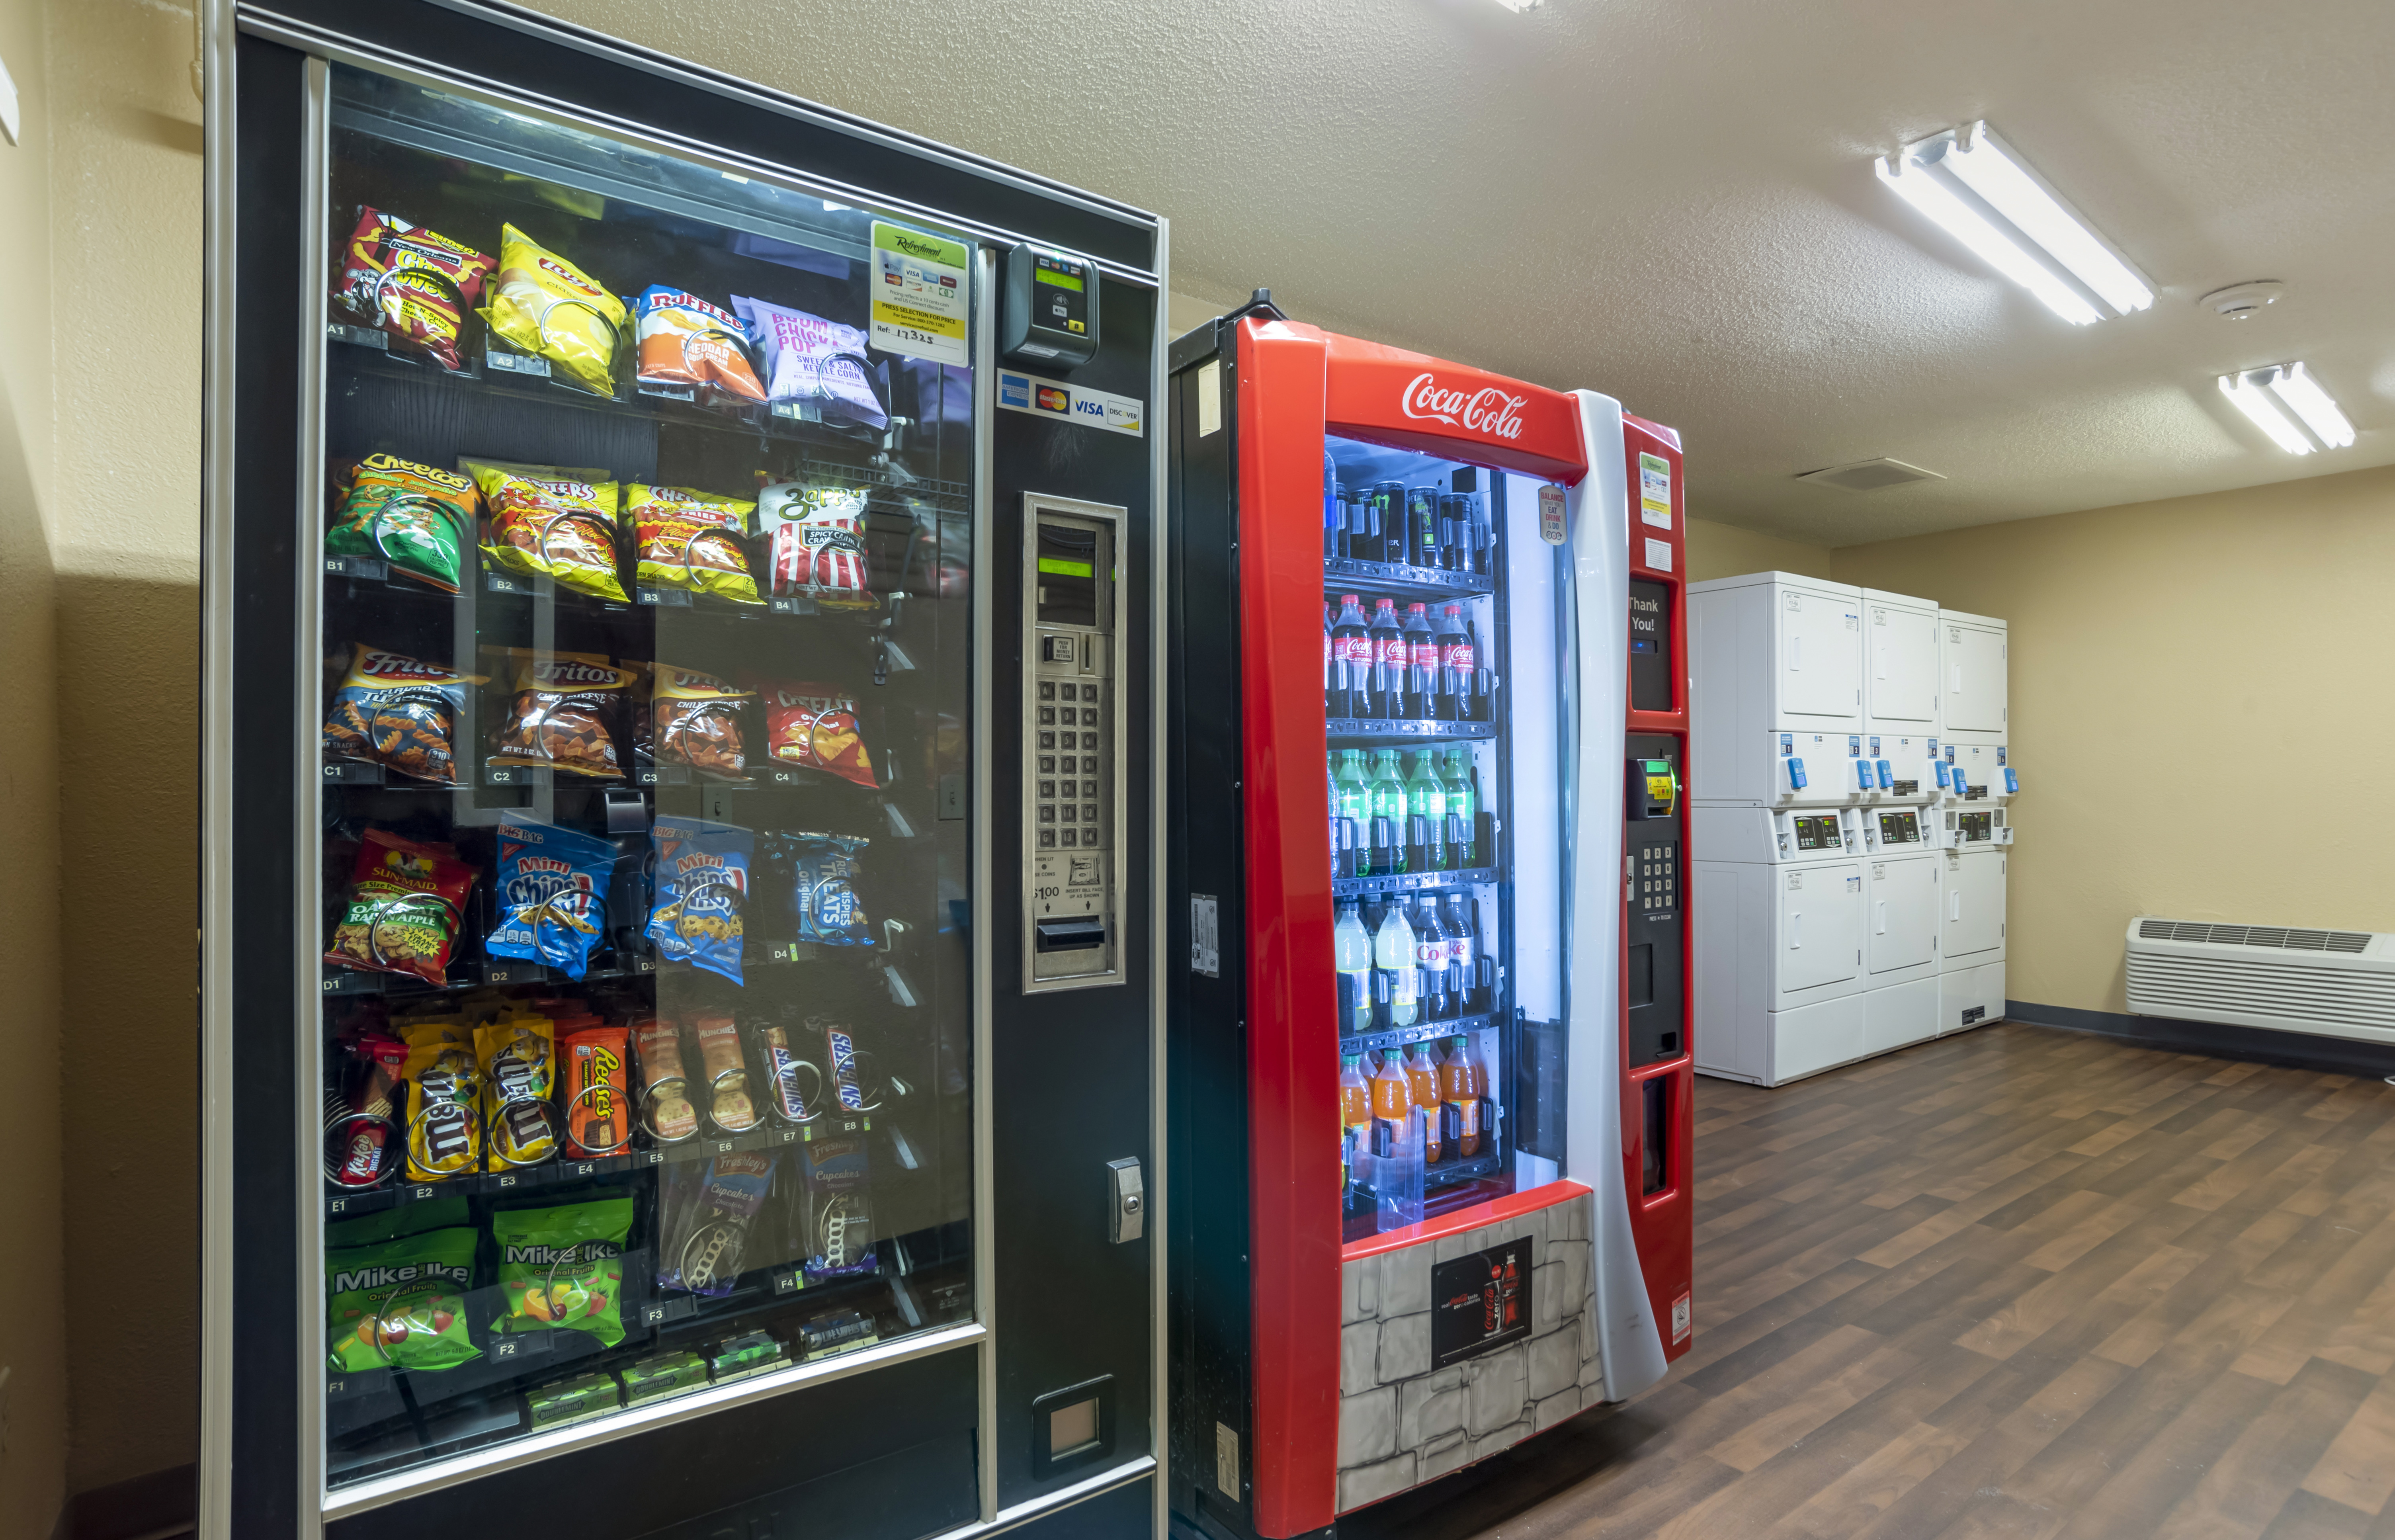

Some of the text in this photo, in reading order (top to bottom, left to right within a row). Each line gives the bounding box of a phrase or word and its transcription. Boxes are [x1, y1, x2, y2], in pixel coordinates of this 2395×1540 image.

[895, 235, 941, 256] Refreshment
[393, 242, 457, 263] New Orleans
[890, 264, 900, 272] Pay
[882, 303, 899, 311] PRESS
[900, 307, 929, 318] SELECTION
[917, 318, 945, 328] 800-370-1282
[327, 325, 343, 334] A1
[877, 325, 934, 344] Ref: 17325
[681, 339, 729, 359] CHEDDAR
[778, 336, 816, 354] POP
[689, 352, 728, 366] SOUR CREAM
[838, 362, 861, 374] SALTY
[744, 373, 756, 383] 230
[838, 369, 860, 380] CORN
[1002, 385, 1028, 393] AMERICAN
[1039, 394, 1065, 405] MasterCard
[778, 406, 791, 415] A4
[1074, 399, 1104, 416] VISA
[1402, 373, 1528, 439] Coca-Cola
[1110, 408, 1137, 419] DISCOVER
[363, 453, 468, 489] Cheetos
[395, 482, 428, 493] Crunchy
[1541, 492, 1563, 502] BALANCE
[1545, 514, 1561, 522] DRINK
[327, 561, 342, 570] B1
[498, 581, 512, 590] B2
[1629, 597, 1658, 612] Thank
[1632, 617, 1654, 631] You!
[533, 661, 617, 683] Fritos
[324, 766, 340, 776] C1
[494, 772, 510, 781] C2
[1085, 784, 1092, 793] 10
[1085, 808, 1092, 817] 12
[498, 824, 543, 843] BIG BAG
[652, 826, 693, 840] BIG BAG
[1064, 833, 1071, 841] 13
[1085, 833, 1092, 841] 14
[518, 856, 572, 876] Mini
[676, 852, 724, 875] Mini
[371, 867, 437, 891] SUN-MAID
[797, 870, 812, 912] original
[840, 882, 851, 926] KRISPIES
[398, 913, 436, 926] APPLE
[413, 934, 435, 948] GRAMS
[641, 962, 655, 970] D3
[492, 972, 508, 981] D2
[324, 980, 339, 990] D1
[639, 1028, 680, 1044] MUNCHIES
[699, 1024, 736, 1040] MUNCHIES
[594, 1046, 620, 1120] Reese's
[844, 1122, 856, 1131] E8
[498, 1129, 508, 1152] PEANUT
[783, 1132, 796, 1141] E7
[719, 1143, 732, 1151] E6
[347, 1135, 372, 1176] KitKat
[650, 1153, 664, 1163] E5
[579, 1165, 593, 1174] E4
[720, 1156, 767, 1172] Freshley's
[501, 1176, 516, 1186] E3
[816, 1169, 860, 1183] Cupcakes
[417, 1188, 433, 1198] E2
[711, 1182, 755, 1201] Cupcakes
[332, 1200, 345, 1212] E1
[716, 1198, 744, 1210] Chocolate
[507, 1245, 576, 1264] Mike
[572, 1265, 594, 1275] Fruits
[336, 1263, 469, 1293] Mike Ike
[781, 1279, 793, 1288] F4
[412, 1283, 437, 1291] Fruits
[1450, 1294, 1468, 1306] Coca-Cola
[1464, 1298, 1481, 1306] calories
[649, 1310, 663, 1320] F3
[1485, 1288, 1494, 1330] Coca-Cola
[500, 1345, 514, 1355] F2
[329, 1382, 344, 1393] F1
[636, 1376, 674, 1393] DOUBLEMINT
[541, 1401, 582, 1420] DOUBLEMINT
